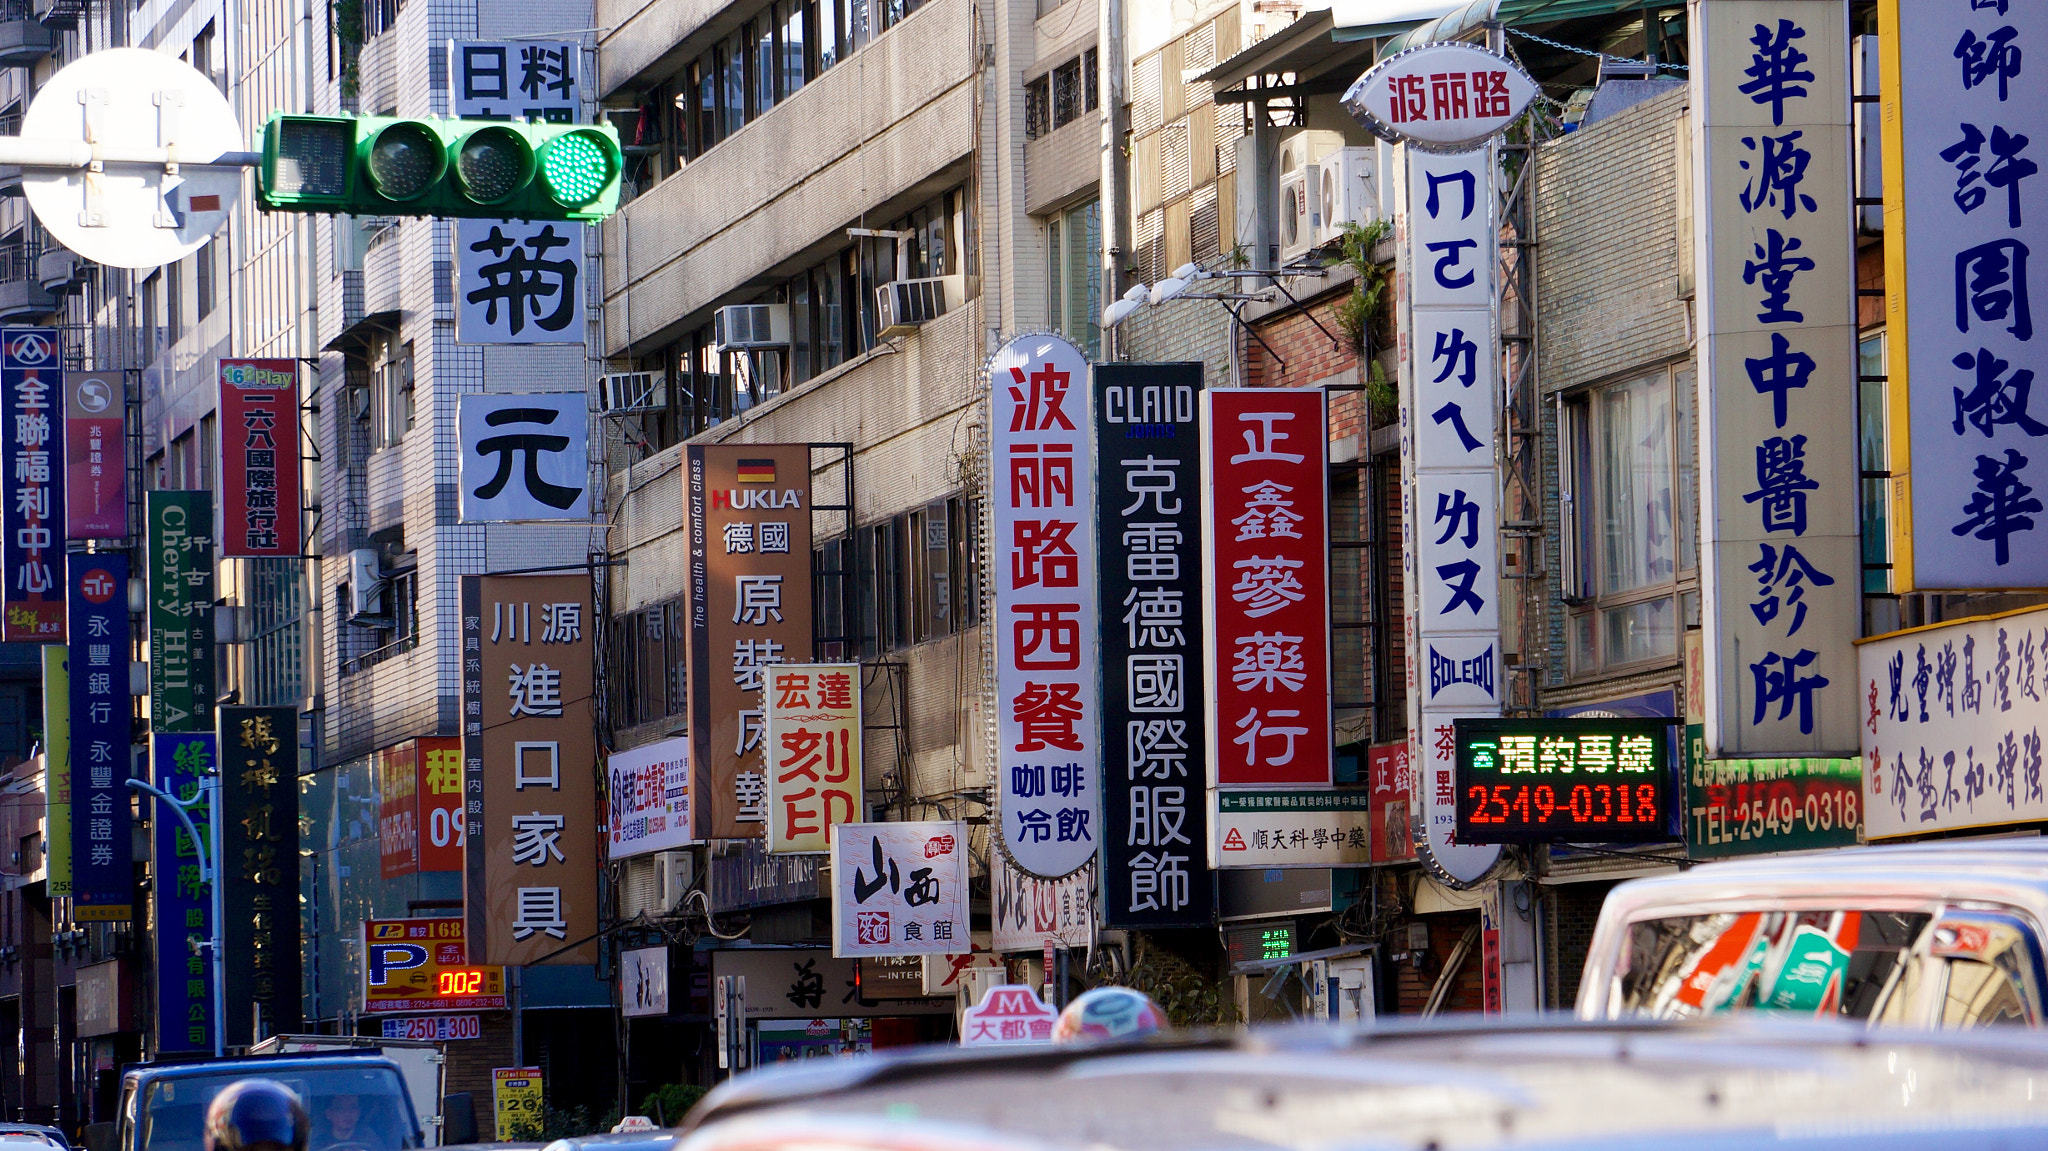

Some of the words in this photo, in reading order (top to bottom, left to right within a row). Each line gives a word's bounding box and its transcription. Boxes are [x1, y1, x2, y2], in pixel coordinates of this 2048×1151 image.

[1939, 0, 2048, 566] 師許周淑華
[467, 225, 582, 510] 菊元
[1738, 18, 1834, 735] 華源堂中醫診所
[1105, 385, 1193, 423] CLAID
[15, 377, 52, 593] 全聯福利中心
[243, 395, 278, 549] 一六八國際旅行社
[692, 459, 701, 492] class
[1401, 407, 1411, 572] BOLERO
[692, 495, 703, 544] comfort
[723, 522, 790, 553] 德國
[158, 504, 187, 617] Cherry
[693, 548, 703, 557] &
[693, 562, 704, 598] health
[7, 605, 39, 633] 生鮮
[491, 602, 581, 643] 川源
[693, 601, 705, 629] The
[88, 615, 112, 724] 永豐銀行
[164, 628, 189, 689] Hill
[465, 616, 482, 737] 家具系統櫥櫃
[1429, 642, 1494, 700] BOLERO
[153, 682, 165, 721] Mirrors
[775, 672, 853, 710] 宏達
[1120, 454, 1191, 912] 克雷德國際服飾
[426, 748, 462, 795] 租
[1498, 735, 1655, 773] 預約專線
[467, 757, 483, 836] 室內設計
[778, 727, 855, 845] 刻印
[1011, 763, 1085, 798] 咖啡
[90, 740, 114, 866] 永豐金證券
[509, 663, 567, 940] 進口家具
[1434, 815, 1456, 825] 193
[1468, 784, 1657, 823] 2549-0318
[1017, 807, 1091, 843] 冷飲
[1251, 826, 1367, 850] 順天科學中藥
[748, 856, 779, 891] Leather
[854, 835, 939, 907] 山西
[369, 943, 430, 986] P
[440, 972, 482, 995] 002
[999, 993, 1027, 1014] M
[406, 1018, 437, 1039] 250
[448, 1016, 479, 1038] 300
[971, 1019, 1052, 1042] 大都會
